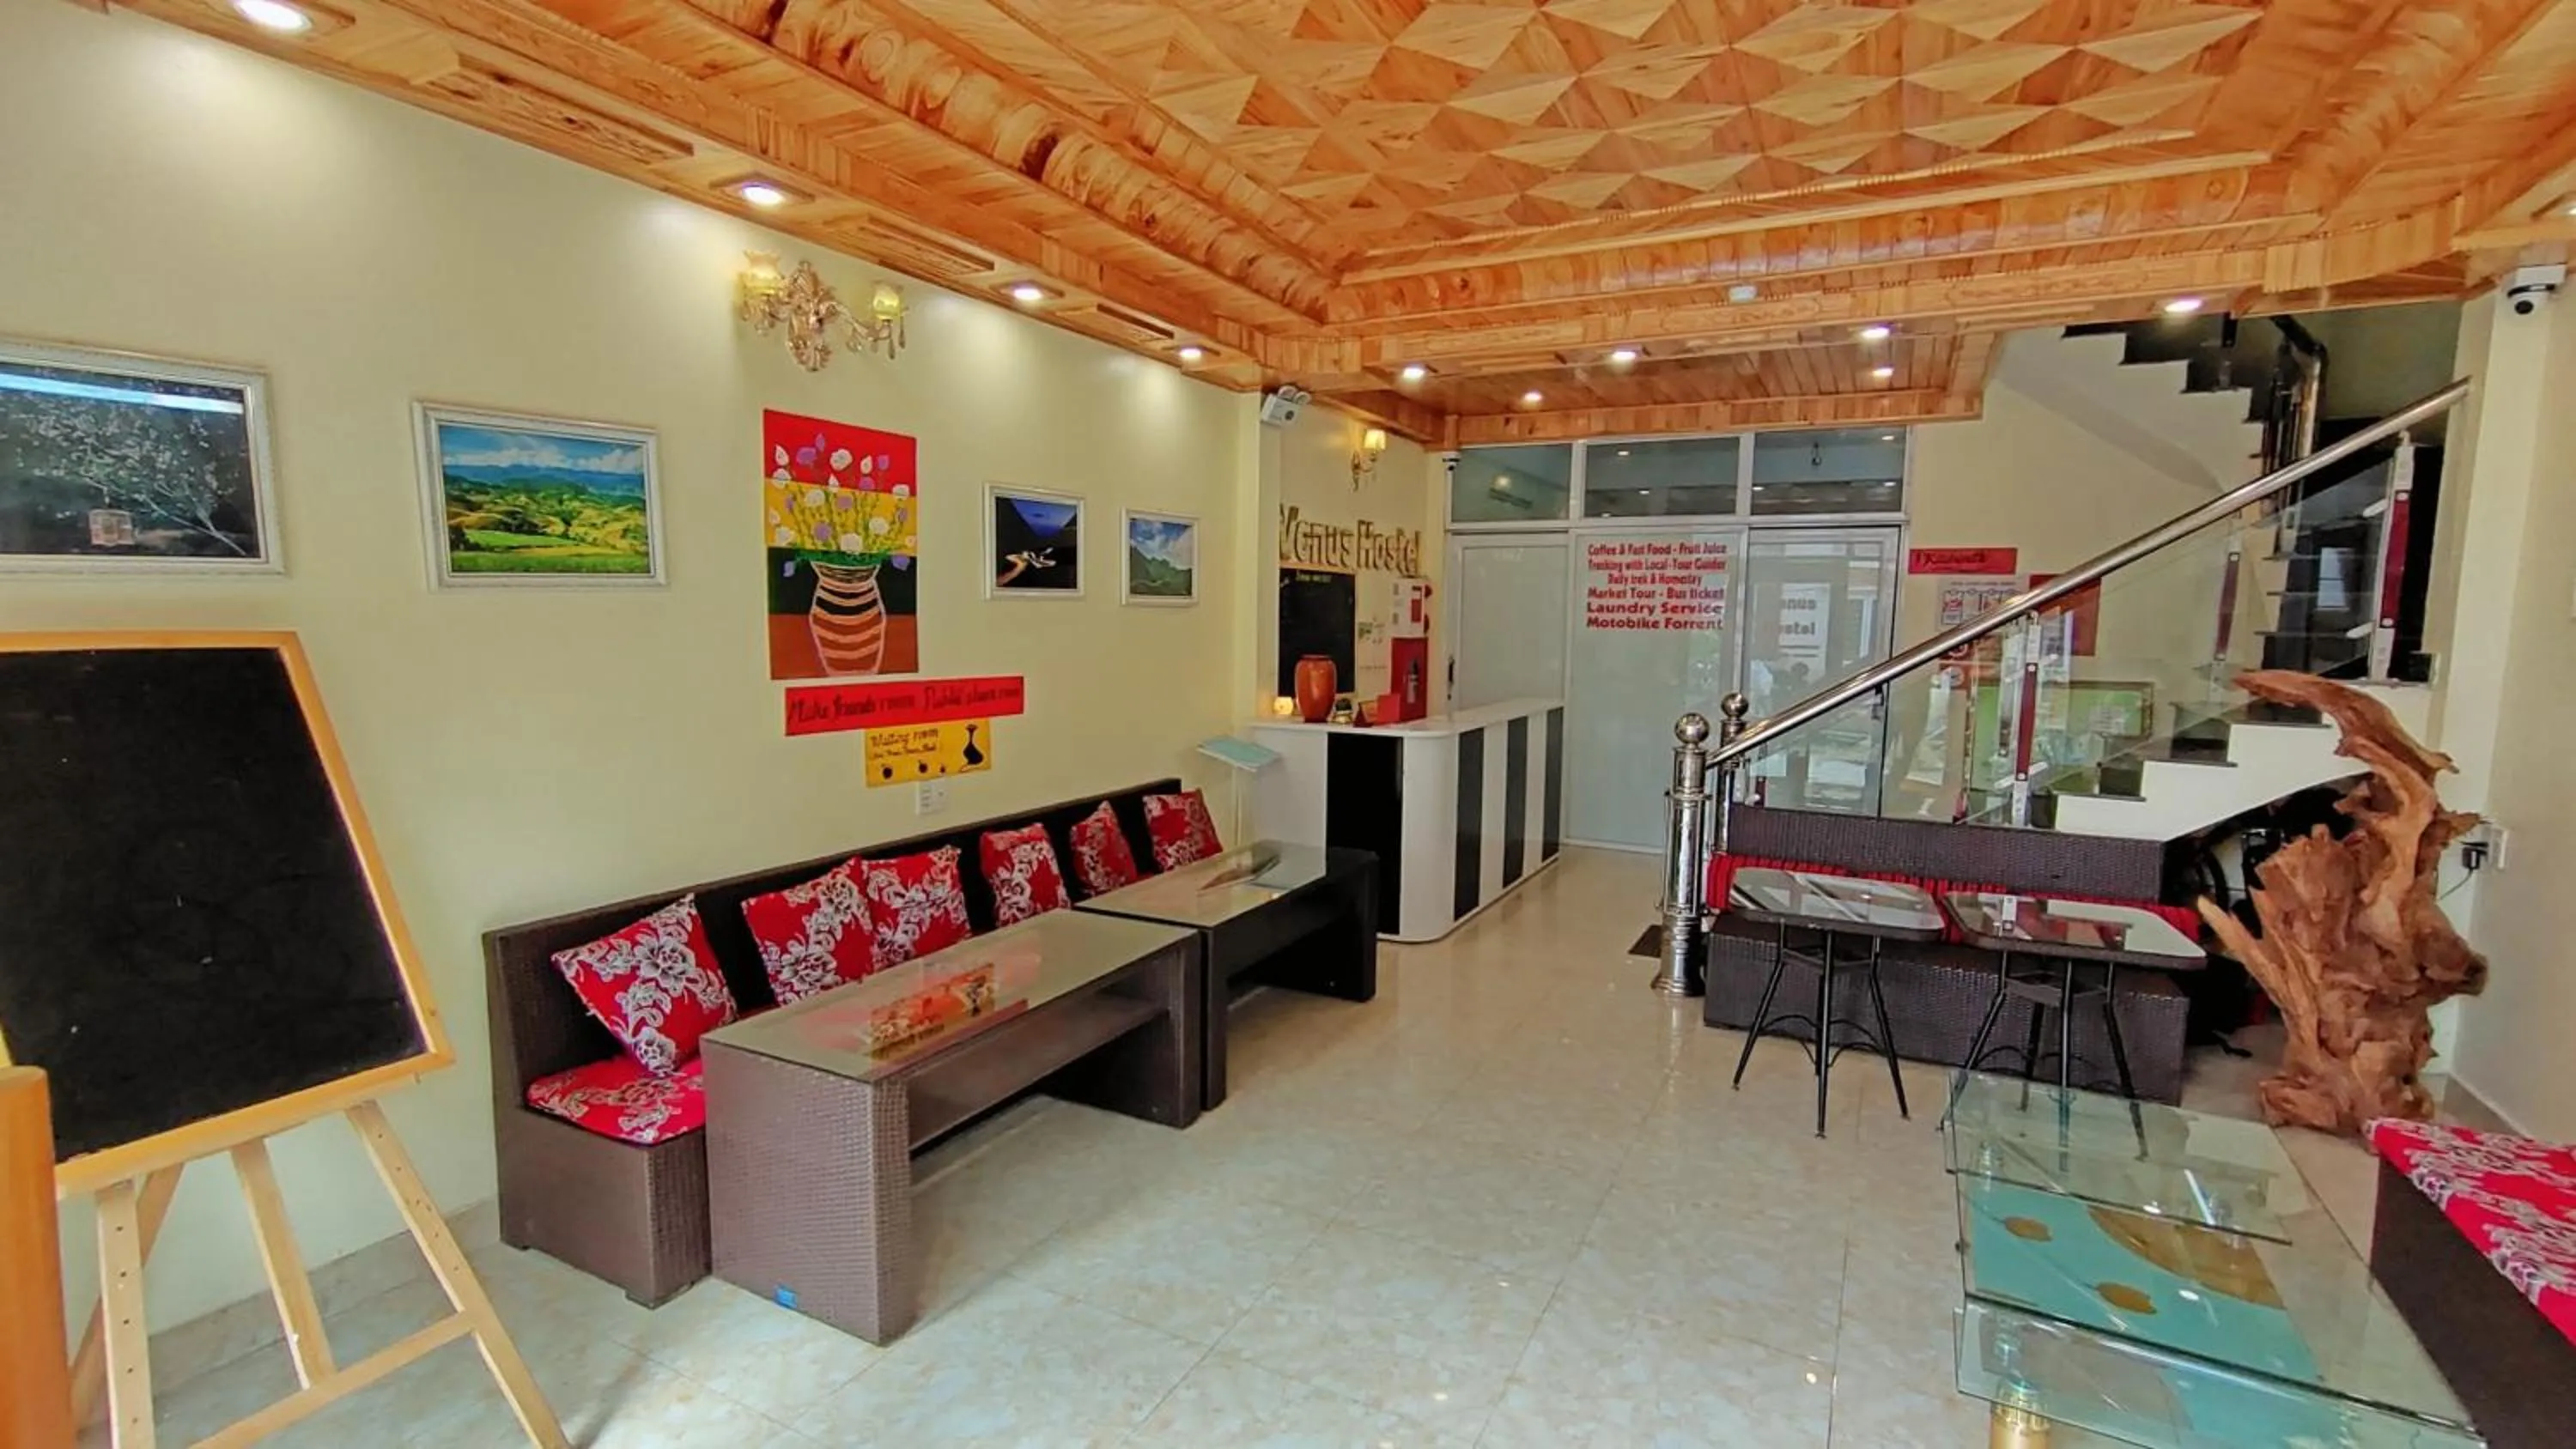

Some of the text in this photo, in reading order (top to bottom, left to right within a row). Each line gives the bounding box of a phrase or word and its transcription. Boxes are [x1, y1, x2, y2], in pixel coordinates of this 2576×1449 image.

[1357, 519, 1422, 577] Hostel
[1589, 543, 1616, 555] Coffee
[1628, 543, 1644, 555] Fast
[1647, 543, 1671, 555] Food
[1680, 542, 1701, 555] Fruit
[1704, 542, 1727, 555] Juice
[1625, 559, 1643, 571] with
[1588, 586, 1627, 599] Market
[1630, 586, 1656, 599] Tour
[1667, 586, 1686, 599] Bus
[1586, 601, 1723, 616] Laundry Service
[1586, 615, 1660, 629] Motobike
